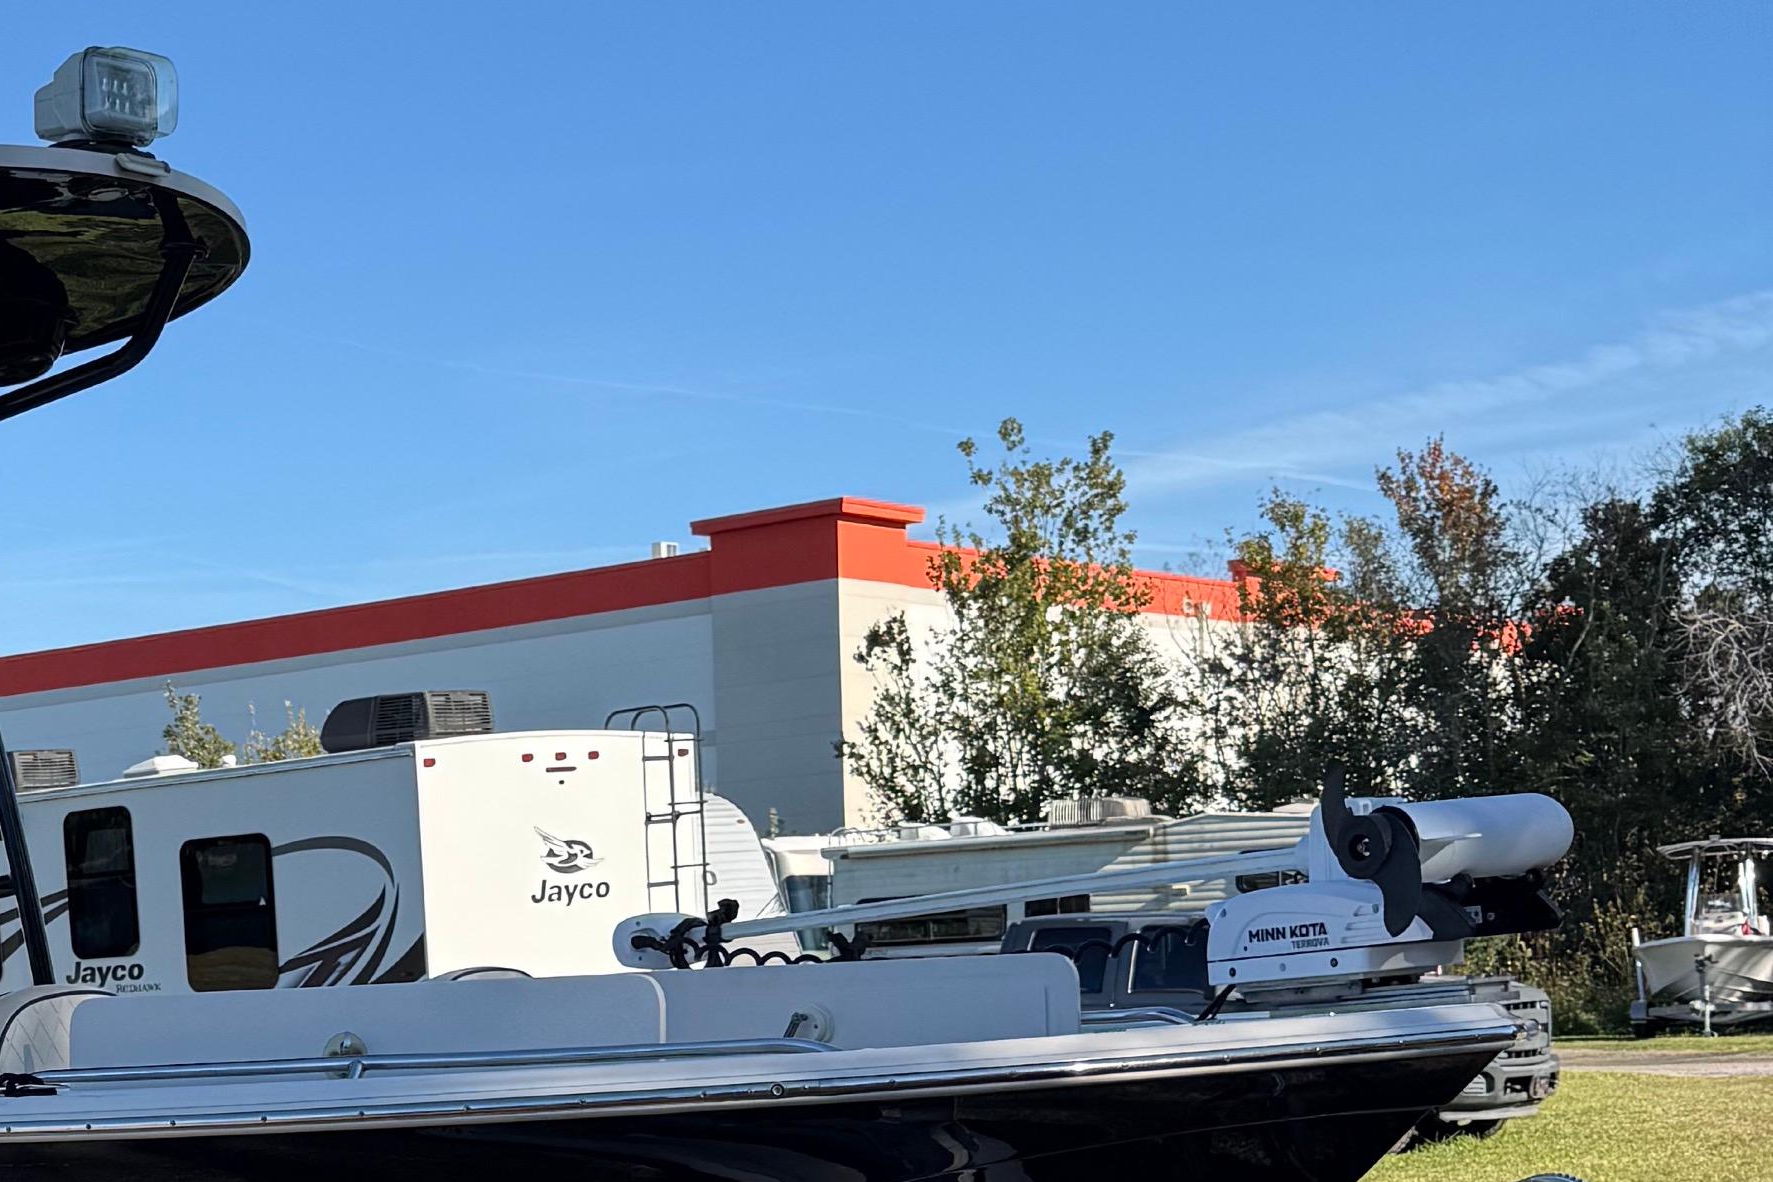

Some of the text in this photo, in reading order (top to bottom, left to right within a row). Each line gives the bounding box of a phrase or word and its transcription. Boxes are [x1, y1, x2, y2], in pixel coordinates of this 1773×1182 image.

[531, 879, 610, 907] Jayco
[1248, 922, 1328, 944] MINN KOTA
[1291, 937, 1330, 949] TERROVA
[65, 961, 144, 988] Jayco
